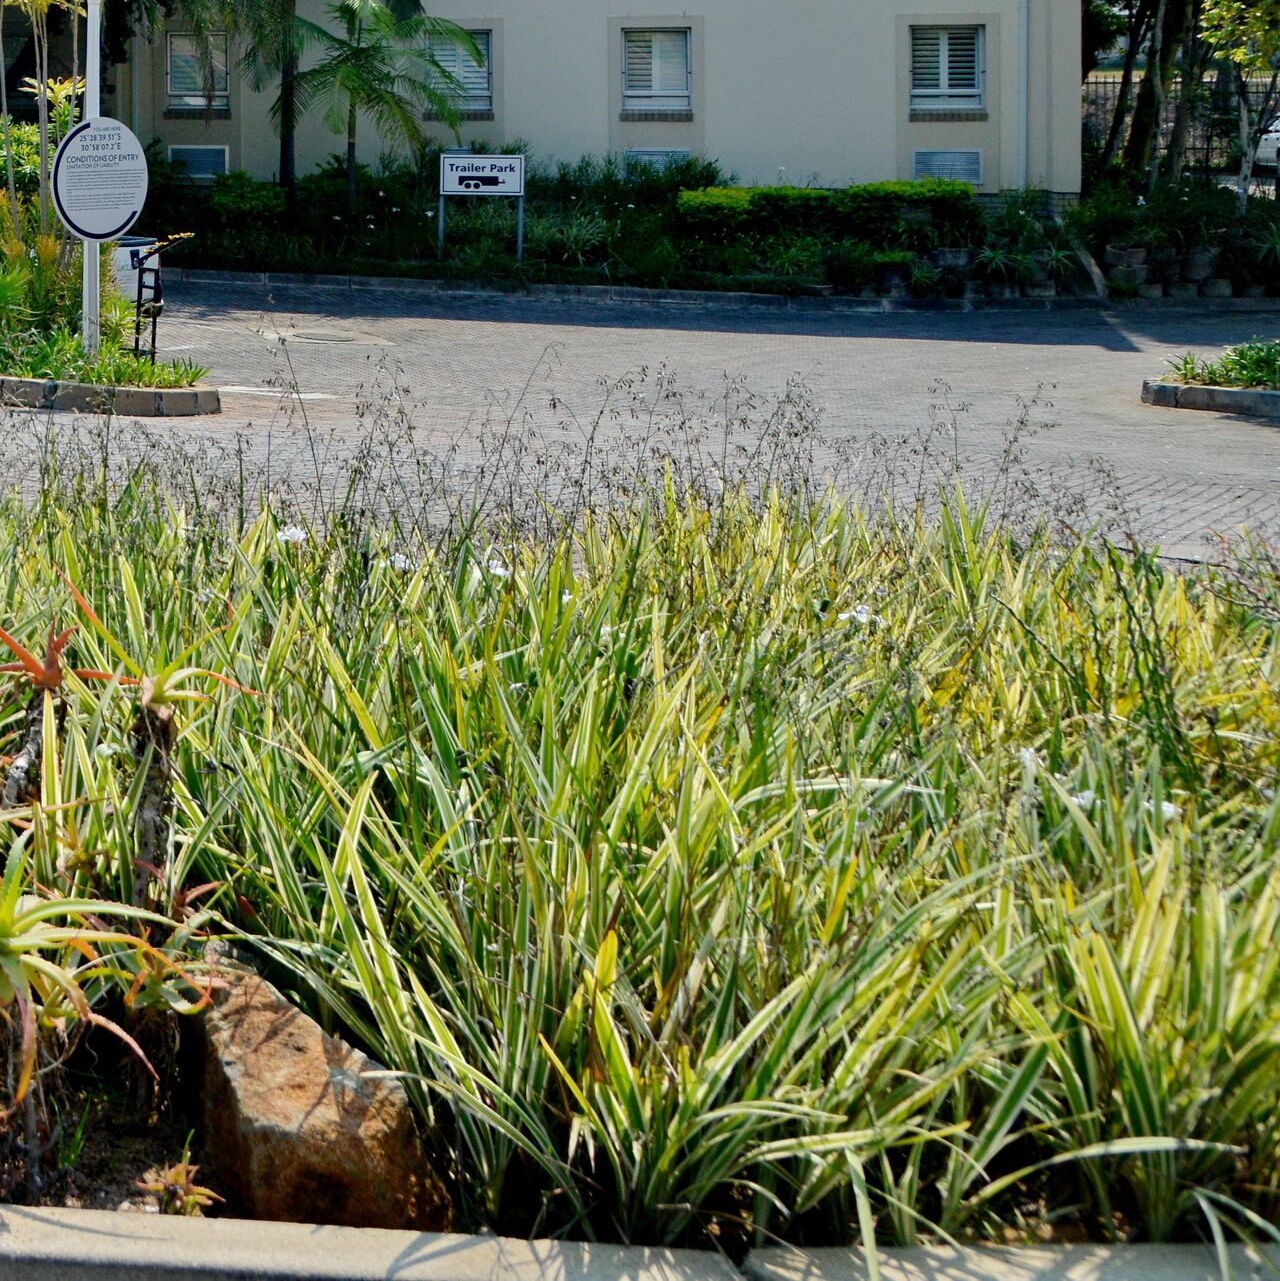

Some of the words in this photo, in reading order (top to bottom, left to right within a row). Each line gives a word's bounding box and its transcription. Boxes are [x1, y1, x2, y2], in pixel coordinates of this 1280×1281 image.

[66, 154, 107, 163] CONDITIONS
[108, 154, 117, 162] OF
[118, 153, 139, 161] ENTRY
[448, 163, 487, 173] Trailer
[490, 163, 516, 173] Park
